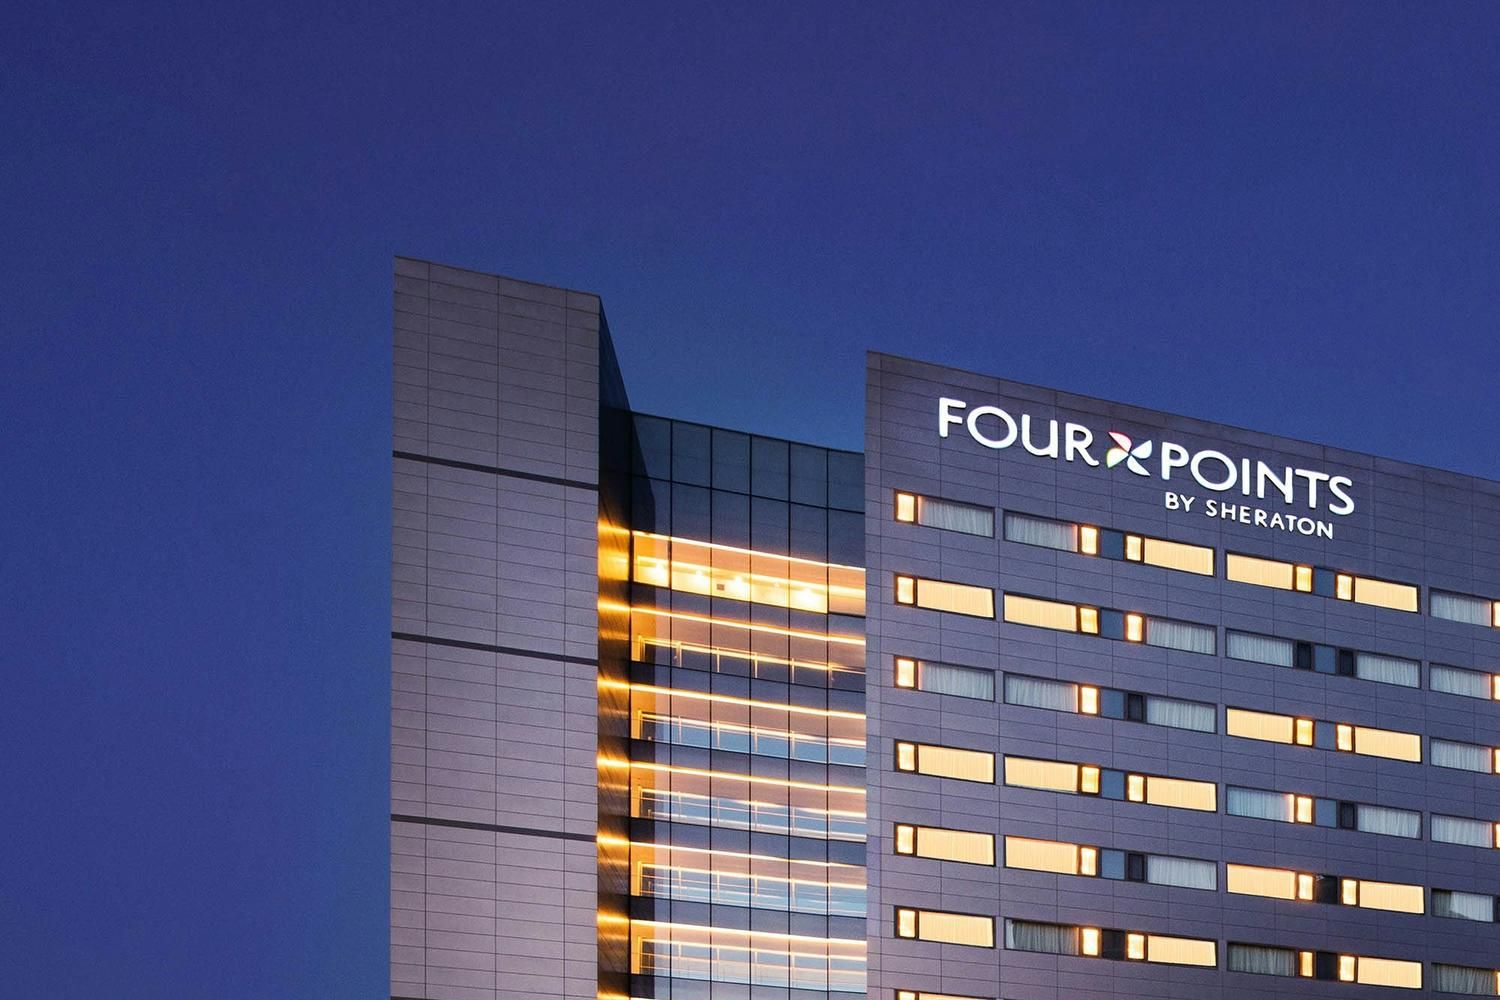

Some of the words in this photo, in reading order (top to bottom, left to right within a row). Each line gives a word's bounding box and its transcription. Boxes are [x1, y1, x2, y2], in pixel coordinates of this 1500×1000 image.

[939, 397, 1099, 467] FOUR
[1161, 441, 1355, 516] POINTS
[1165, 491, 1195, 513] BY
[1206, 499, 1334, 540] SHERATON
